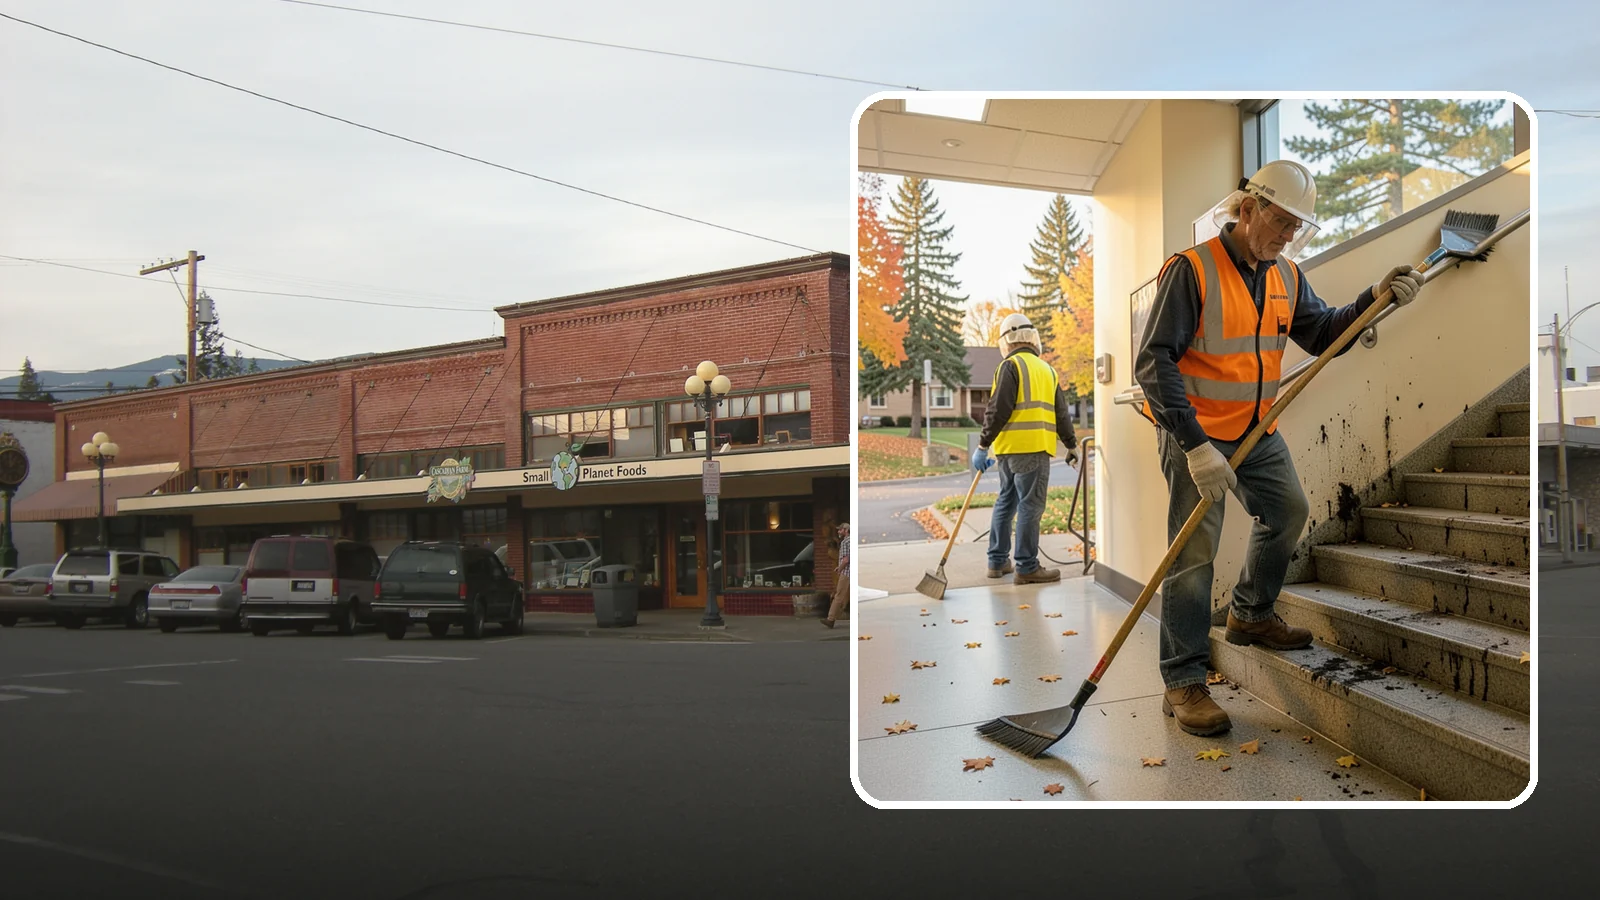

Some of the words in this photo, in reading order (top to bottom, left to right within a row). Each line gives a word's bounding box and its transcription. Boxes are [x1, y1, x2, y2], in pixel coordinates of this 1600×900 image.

[523, 470, 549, 483] Small
[583, 467, 614, 479] Planet
[617, 464, 647, 476] Foods
